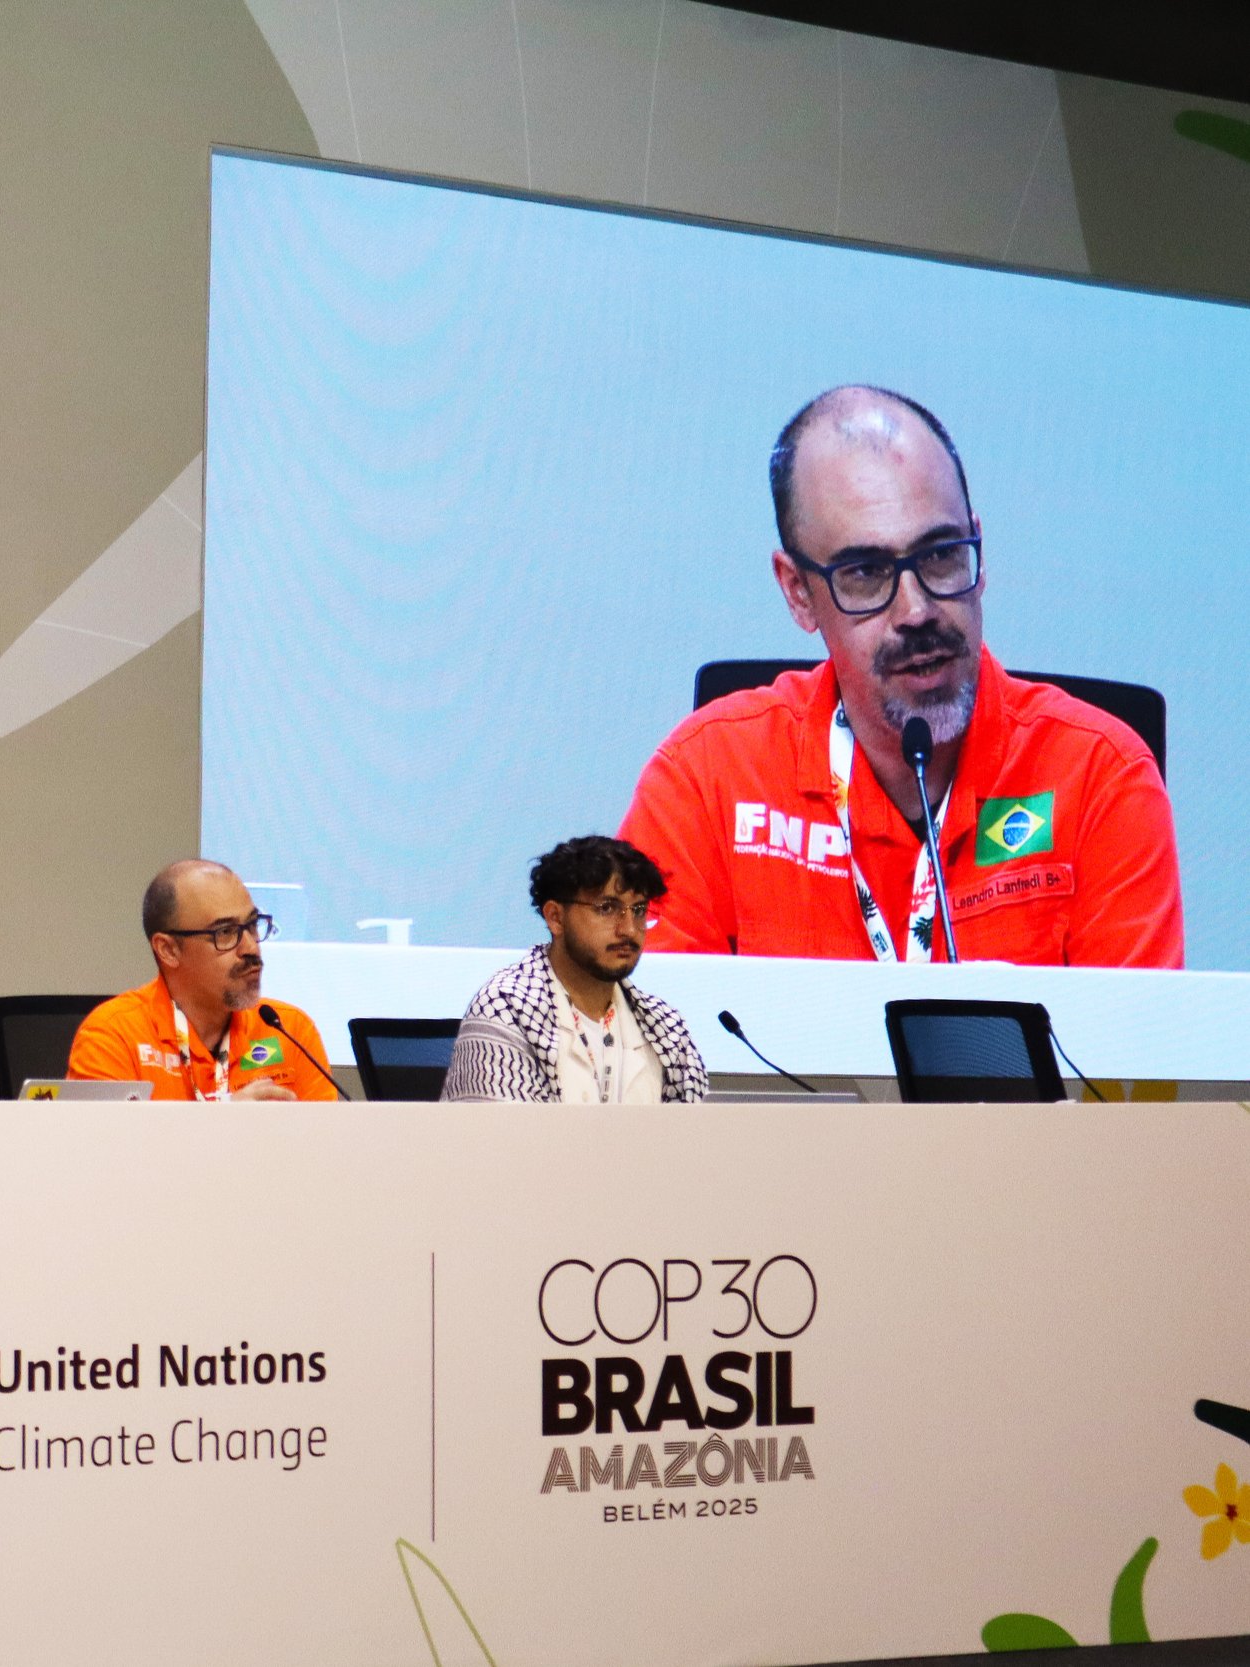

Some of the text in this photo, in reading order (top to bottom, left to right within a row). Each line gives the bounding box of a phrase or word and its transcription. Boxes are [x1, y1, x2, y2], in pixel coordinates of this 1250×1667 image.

[734, 801, 849, 863] FNP
[952, 887, 994, 910] Leandro
[537, 1253, 819, 1348] COP30
[158, 1339, 328, 1389] Nations
[540, 1349, 816, 1438] BRASIL
[170, 1416, 328, 1472] Change
[539, 1431, 816, 1495] AMAZÔNIA
[602, 1497, 759, 1524] BELÉM 2025
